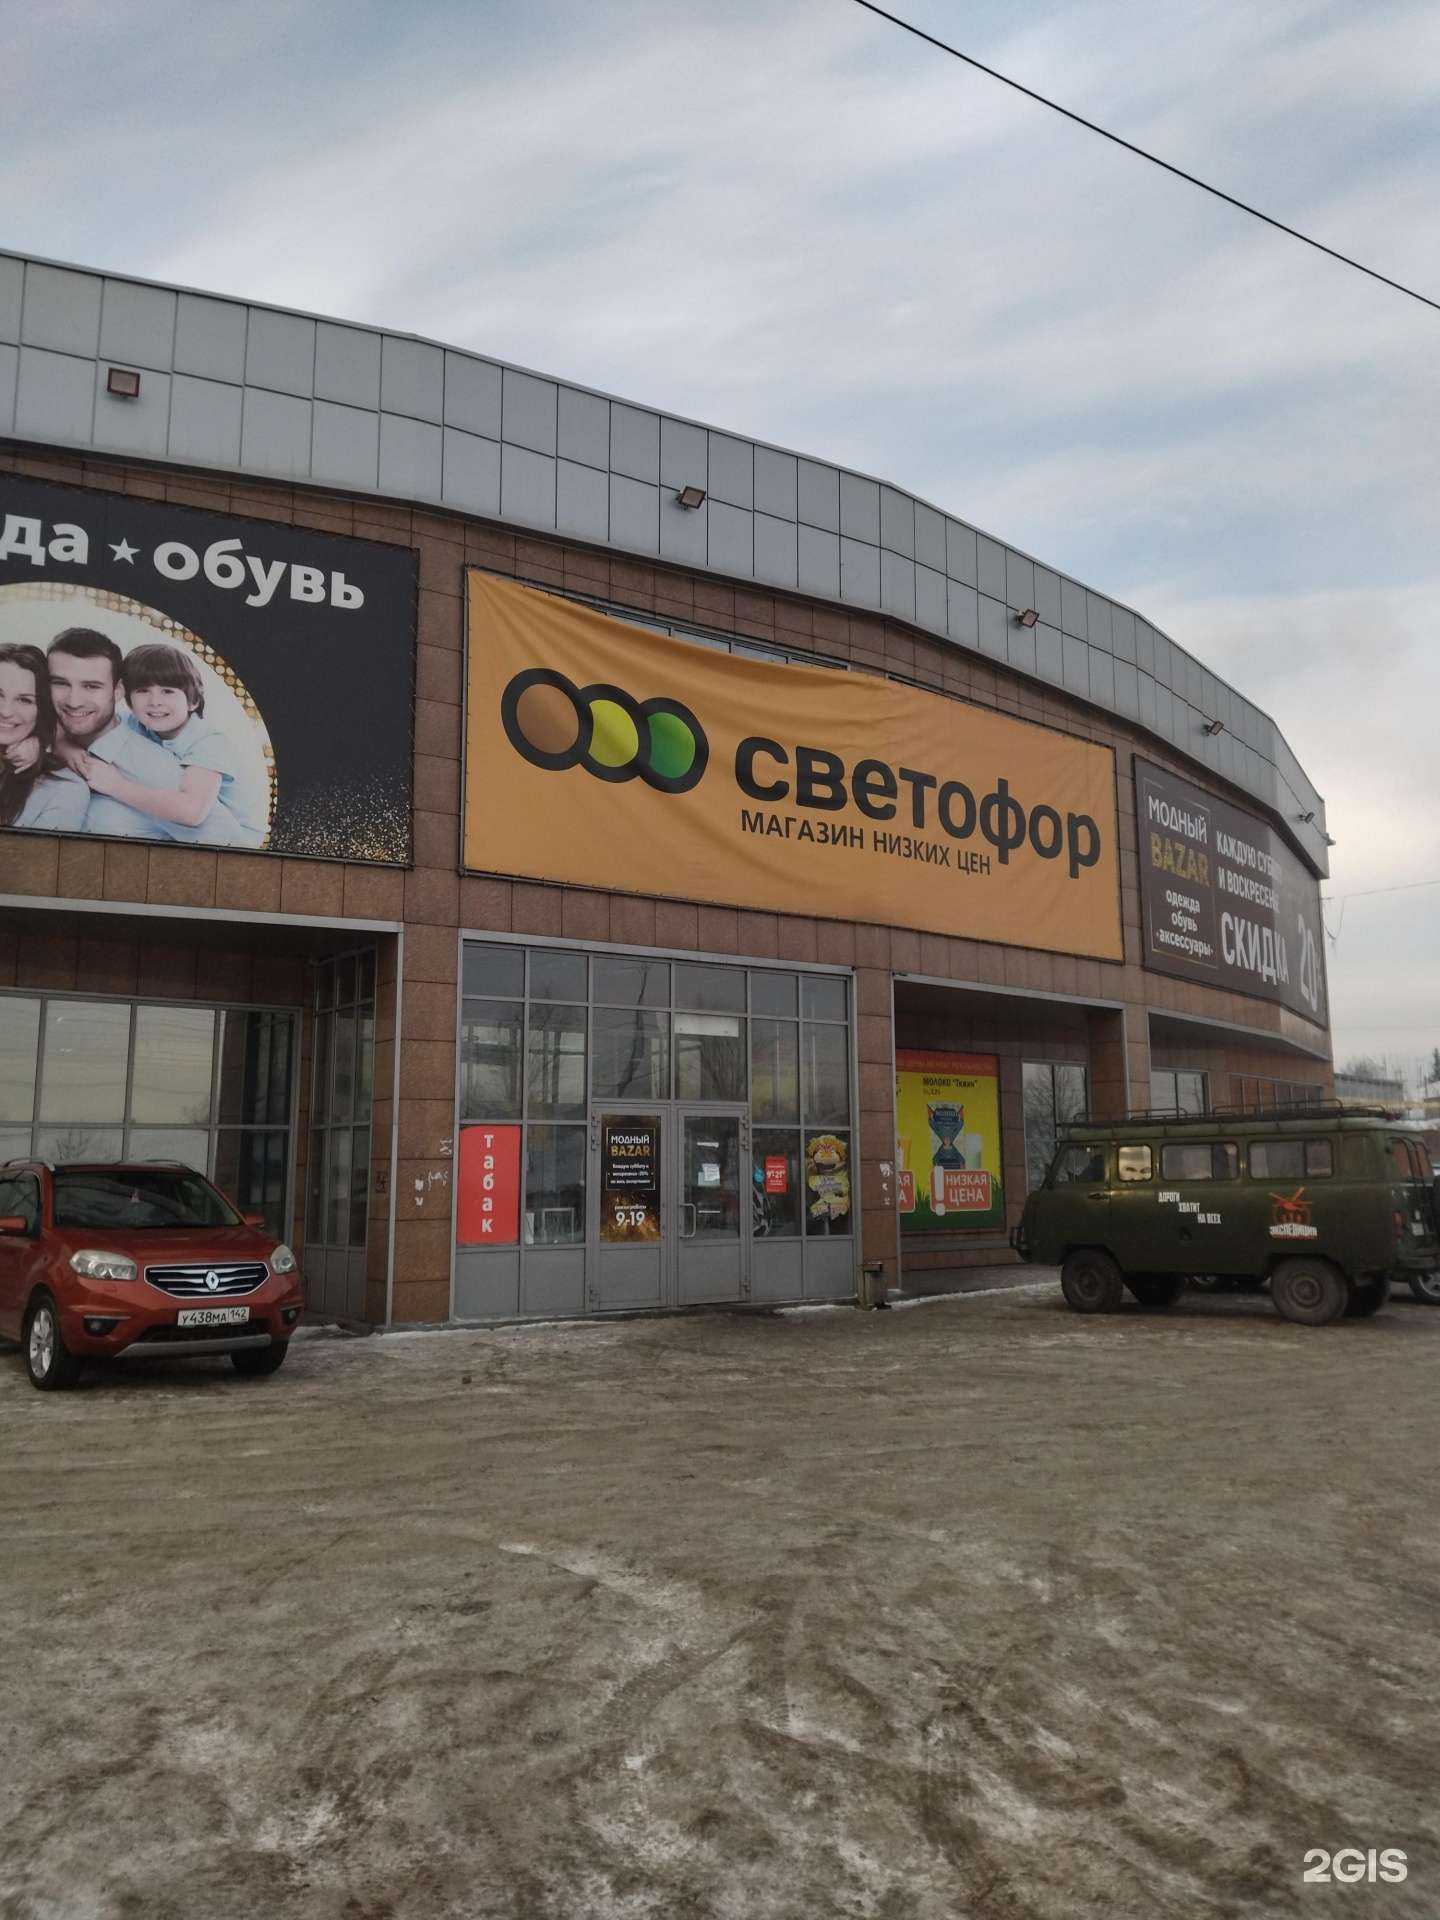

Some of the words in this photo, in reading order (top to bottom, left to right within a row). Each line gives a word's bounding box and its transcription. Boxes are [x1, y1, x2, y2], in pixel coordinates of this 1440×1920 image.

[153, 538, 365, 609] обувь
[1149, 796, 1207, 844] МОДНЫЙ
[741, 809, 864, 849] МАГАЗИН
[873, 830, 950, 867] НИЗКИХ
[957, 849, 990, 876] ЦЕН
[1216, 831, 1256, 869] КАЖДУЮ
[1150, 832, 1210, 888] BAZAR
[1218, 866, 1226, 890] И
[1166, 890, 1200, 913] одежда
[1171, 911, 1198, 933] обувь
[1221, 911, 1290, 986] СКИДКА
[611, 1134, 650, 1144] МОДНЫЙ
[611, 1145, 650, 1156] BAZAR
[945, 1174, 988, 1186] НИЗКАЯ
[949, 1187, 985, 1206] ЦЕНА
[616, 1211, 646, 1226] 9-19
[230, 1308, 247, 1319] 142
